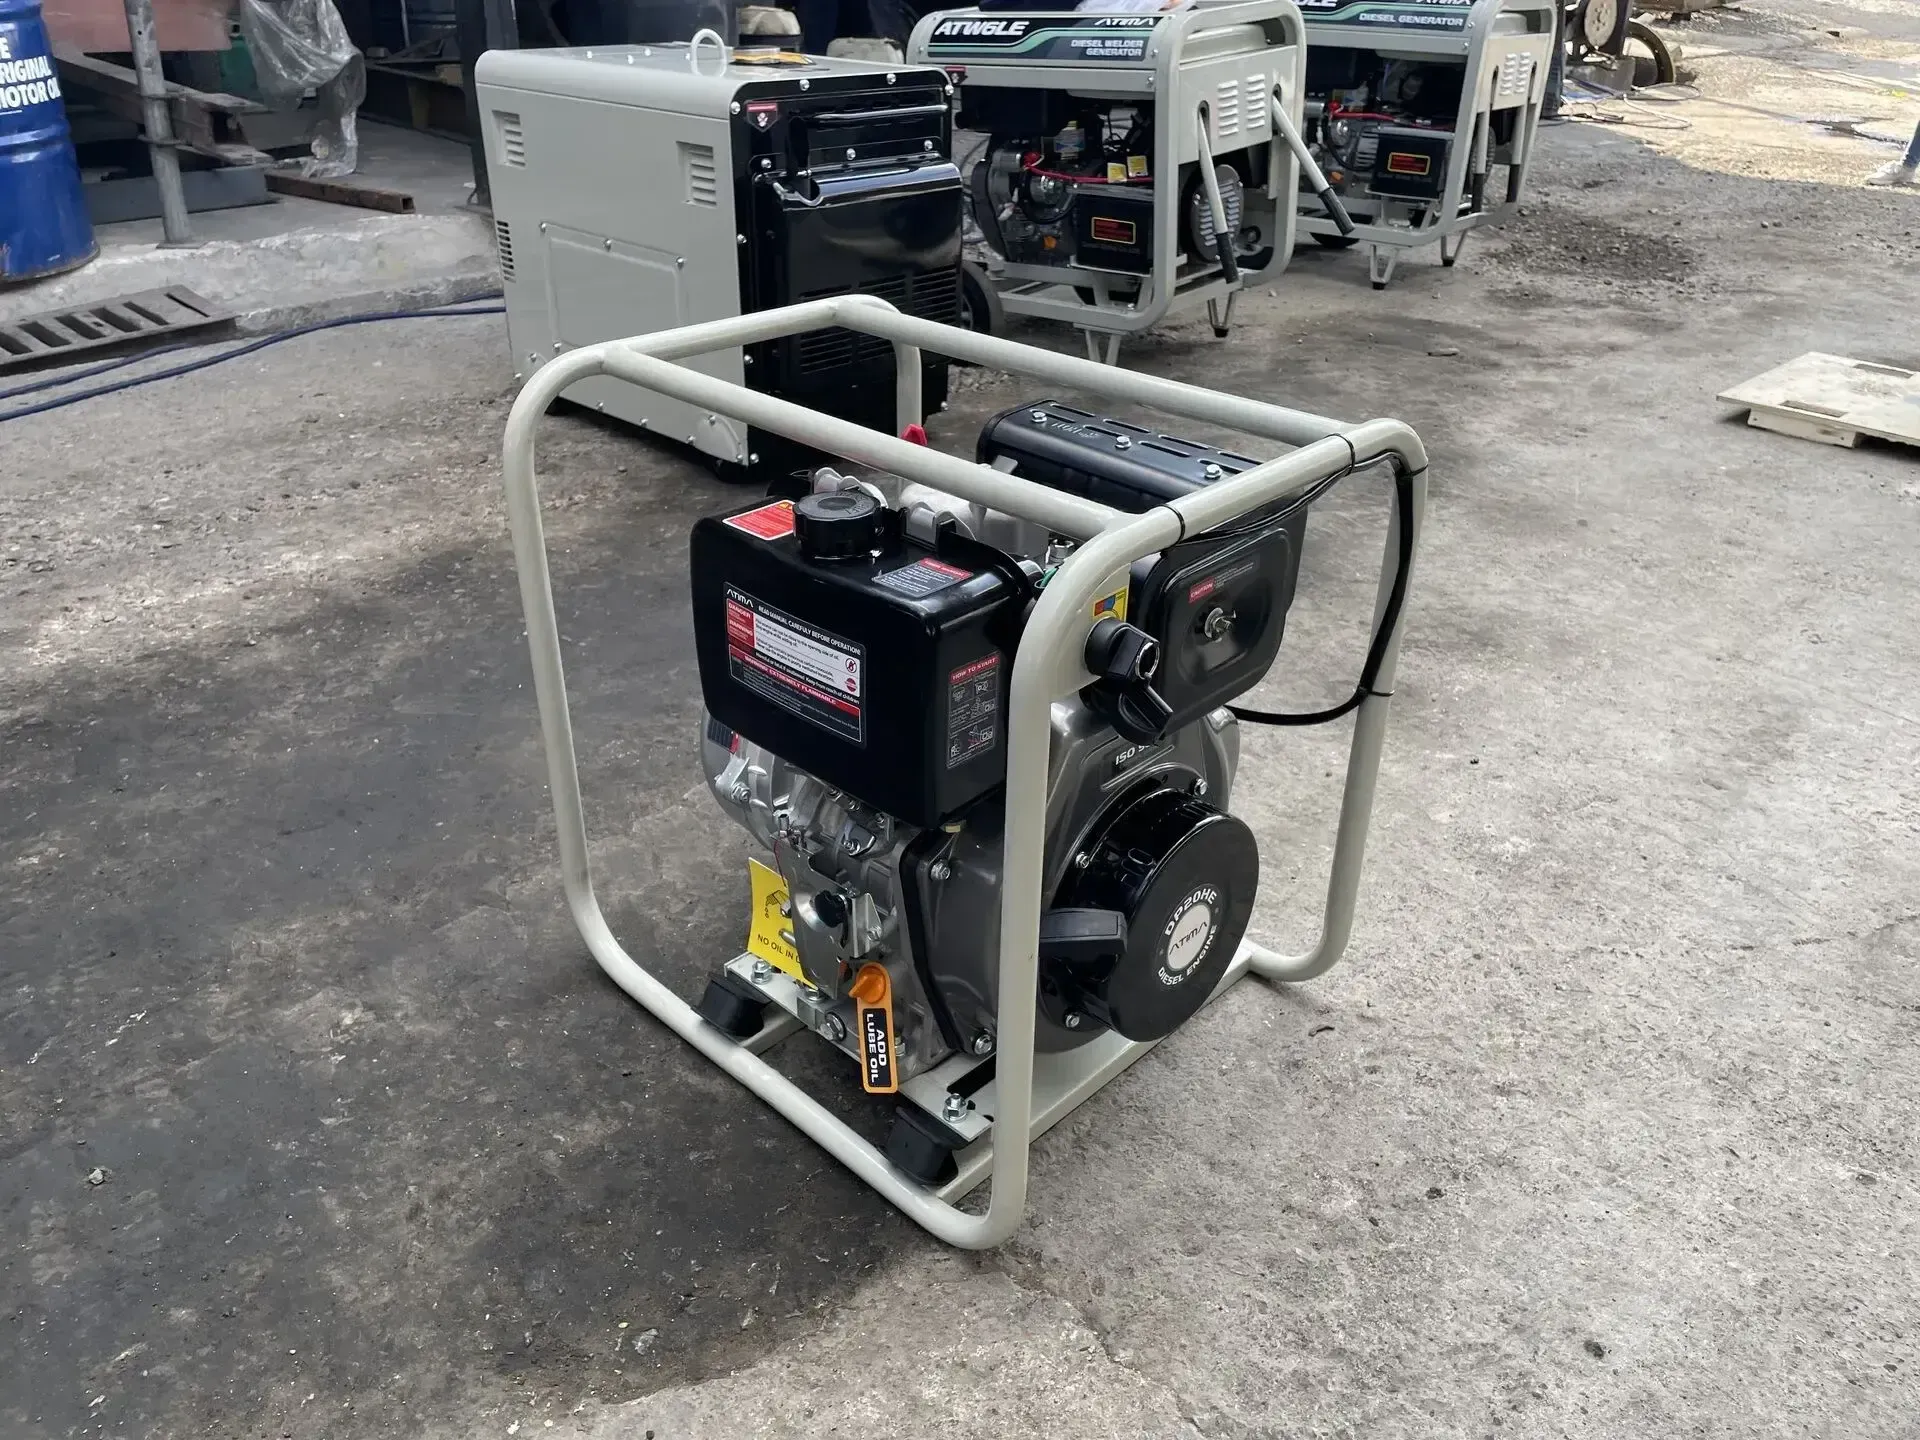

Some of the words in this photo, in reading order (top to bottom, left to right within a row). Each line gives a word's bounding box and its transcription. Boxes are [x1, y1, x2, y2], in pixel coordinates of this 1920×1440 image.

[1095, 18, 1154, 26] ATIMA
[1358, 14, 1396, 22] DIESEL
[1398, 16, 1463, 26] GENERATOR
[1070, 38, 1104, 48] DIESEL
[1105, 39, 1144, 48] WELDER
[1086, 48, 1142, 56] GENERATOR
[726, 588, 754, 608] ATIMA
[728, 602, 751, 619] DANGER
[729, 620, 754, 636] WARNING
[758, 606, 770, 616] READ
[811, 630, 830, 644] BEFORE
[952, 669, 967, 680] HOW
[968, 666, 976, 674] TO
[976, 658, 996, 670] START
[1116, 747, 1136, 766] ISO
[1165, 888, 1217, 936] DP20HE
[758, 934, 769, 946] NO
[770, 942, 784, 954] OIL
[785, 950, 794, 960] IN
[1169, 921, 1208, 955] ATIMA
[1158, 966, 1184, 986] DIESEL
[1186, 924, 1218, 976] ENGINE
[866, 1014, 876, 1053] LUBE
[876, 1029, 887, 1066] ADD
[870, 1057, 880, 1083] OIL
